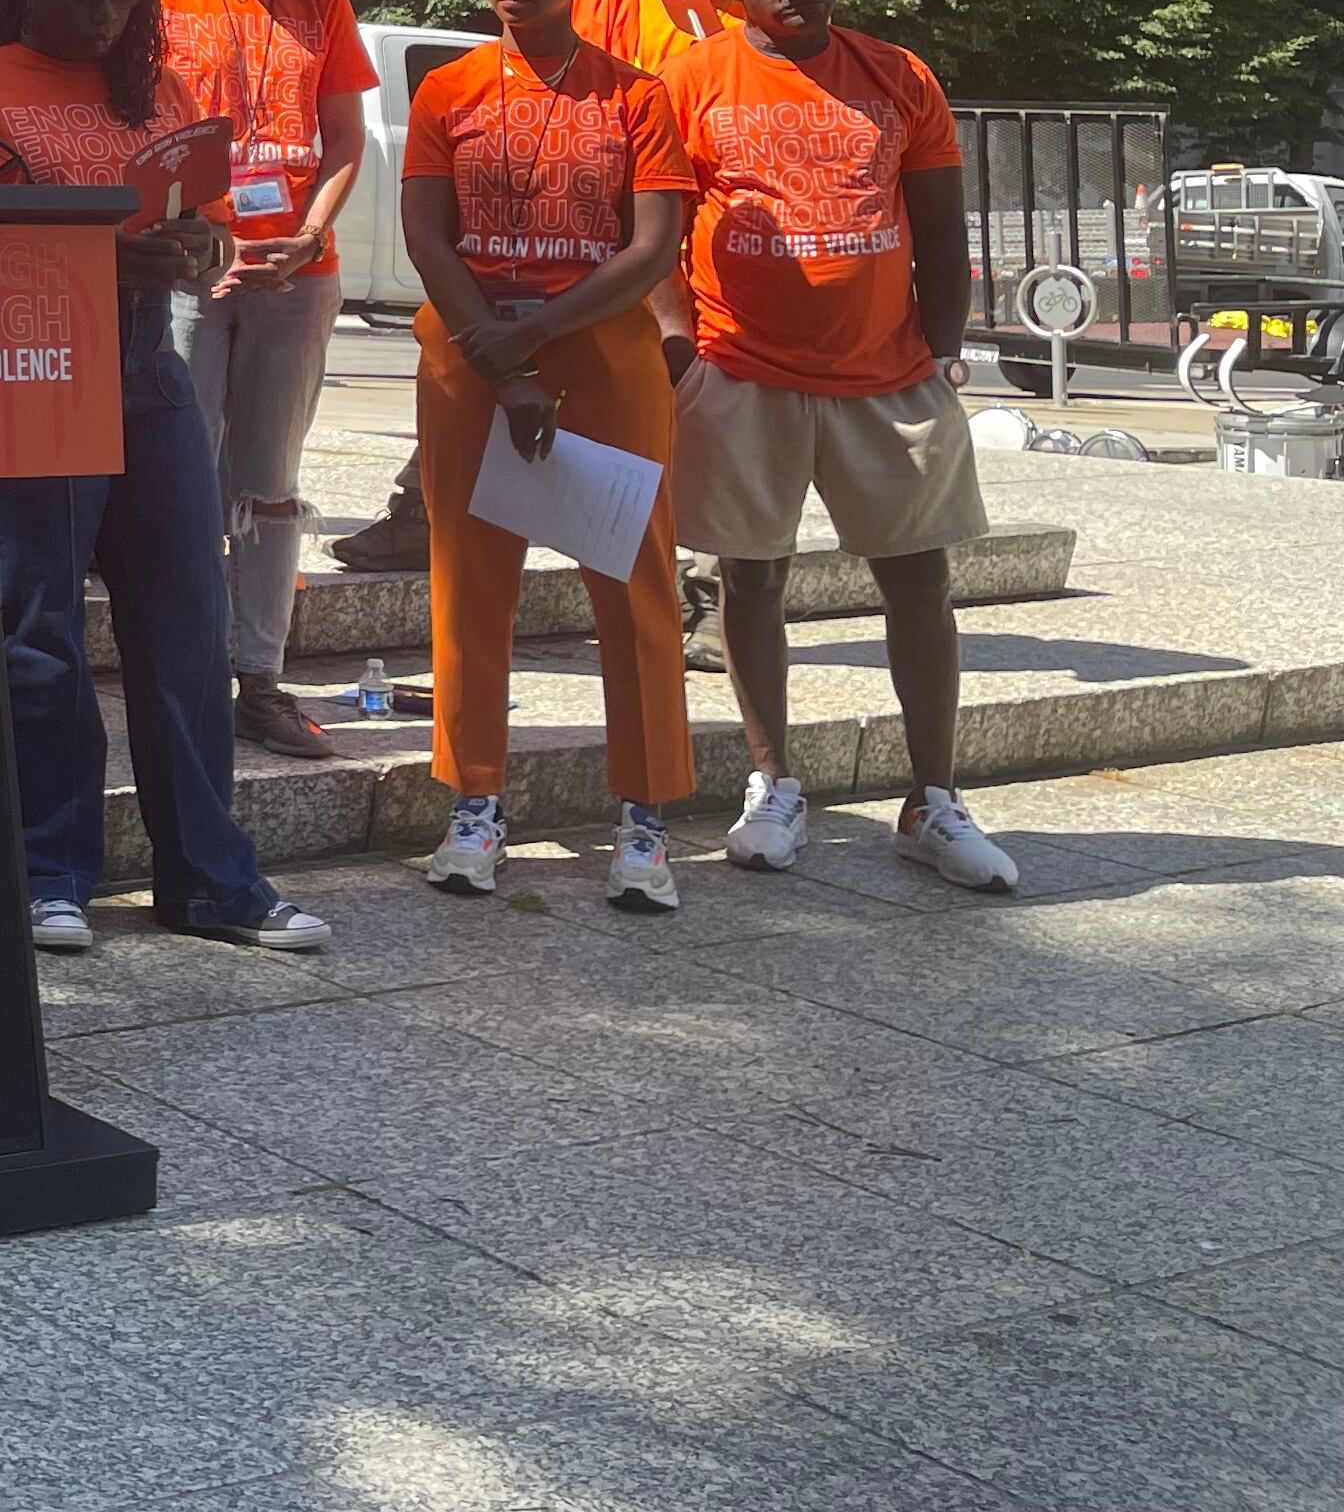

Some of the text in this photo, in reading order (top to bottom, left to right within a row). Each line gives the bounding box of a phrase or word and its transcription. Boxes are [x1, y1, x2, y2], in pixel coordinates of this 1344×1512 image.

[709, 99, 902, 138] ENOUGH
[14, 130, 167, 165] ENOU
[487, 235, 530, 259] GUN
[534, 237, 619, 264] VIOLENCE
[726, 224, 902, 258] END GUN VIOLENCE
[1232, 439, 1247, 473] YAM
